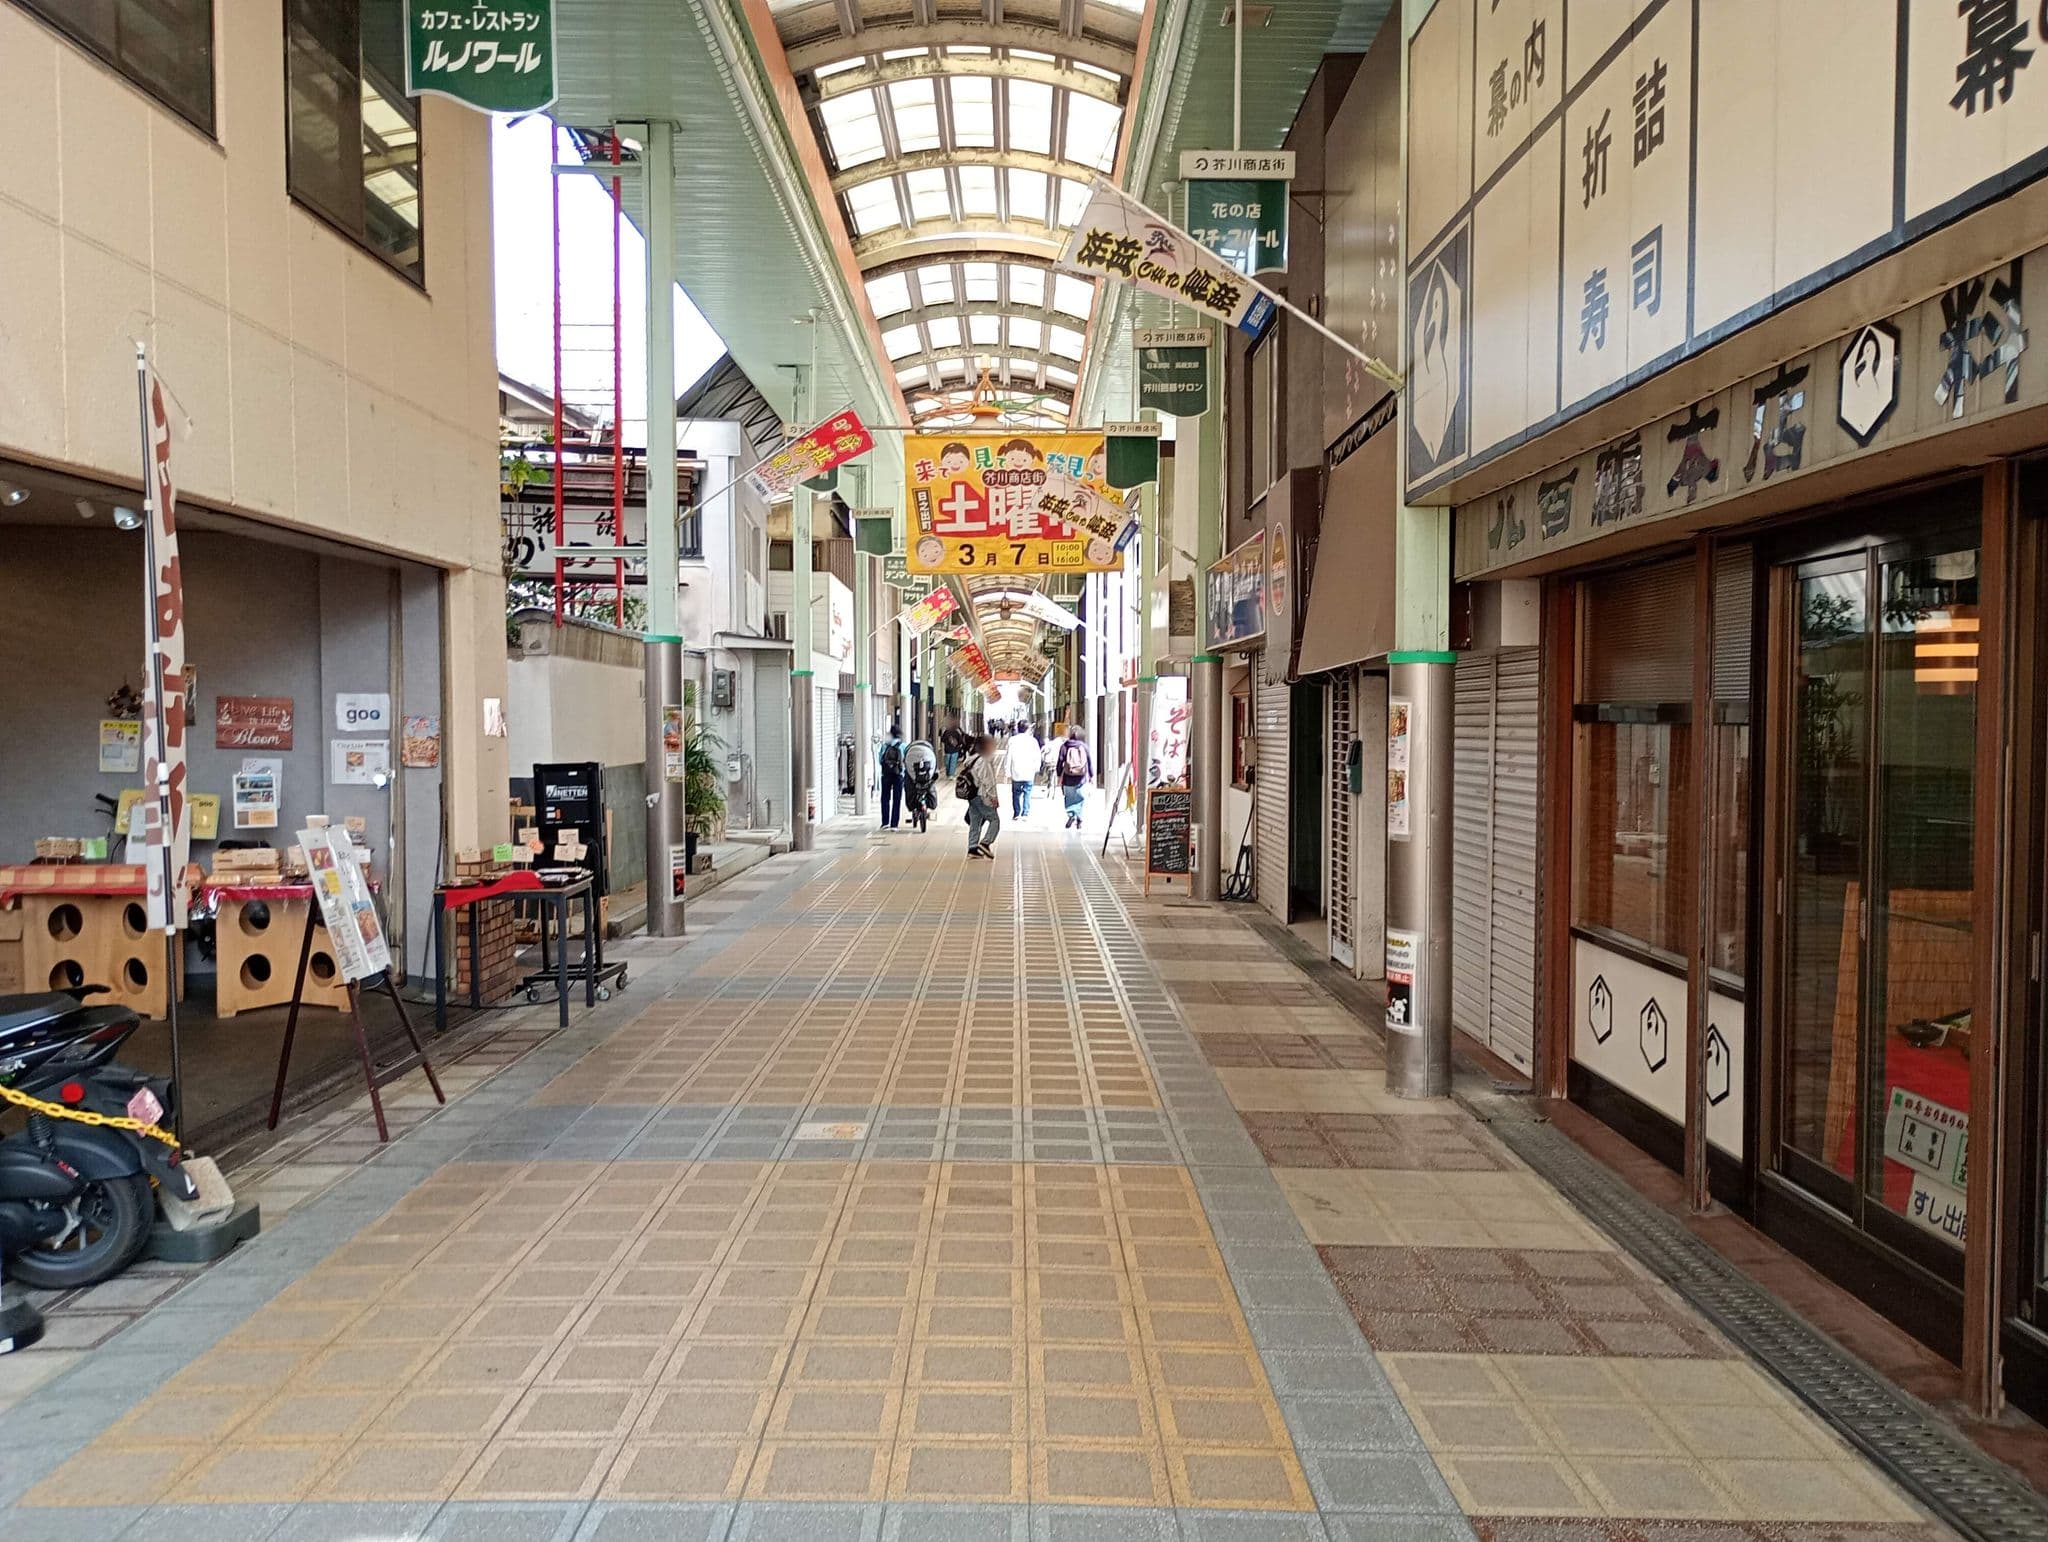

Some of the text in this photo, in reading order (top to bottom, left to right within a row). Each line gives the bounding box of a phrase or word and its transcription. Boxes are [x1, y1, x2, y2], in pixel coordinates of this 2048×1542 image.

[421, 9, 540, 32] カフェ・レストラン
[422, 40, 542, 74] ルノワール
[1948, 0, 2048, 119] 幕
[1487, 18, 1546, 138] 幕の内
[1212, 158, 1286, 171] 芥川商店街
[1211, 202, 1262, 219] 花の店
[1579, 224, 1664, 355] 寿司
[1154, 333, 1206, 342] 芥川商店街
[914, 459, 950, 482] 来て
[975, 446, 1007, 470] 見て
[984, 471, 1045, 485] 芥川商店街
[346, 709, 381, 724] goo
[231, 727, 282, 745] Bloom
